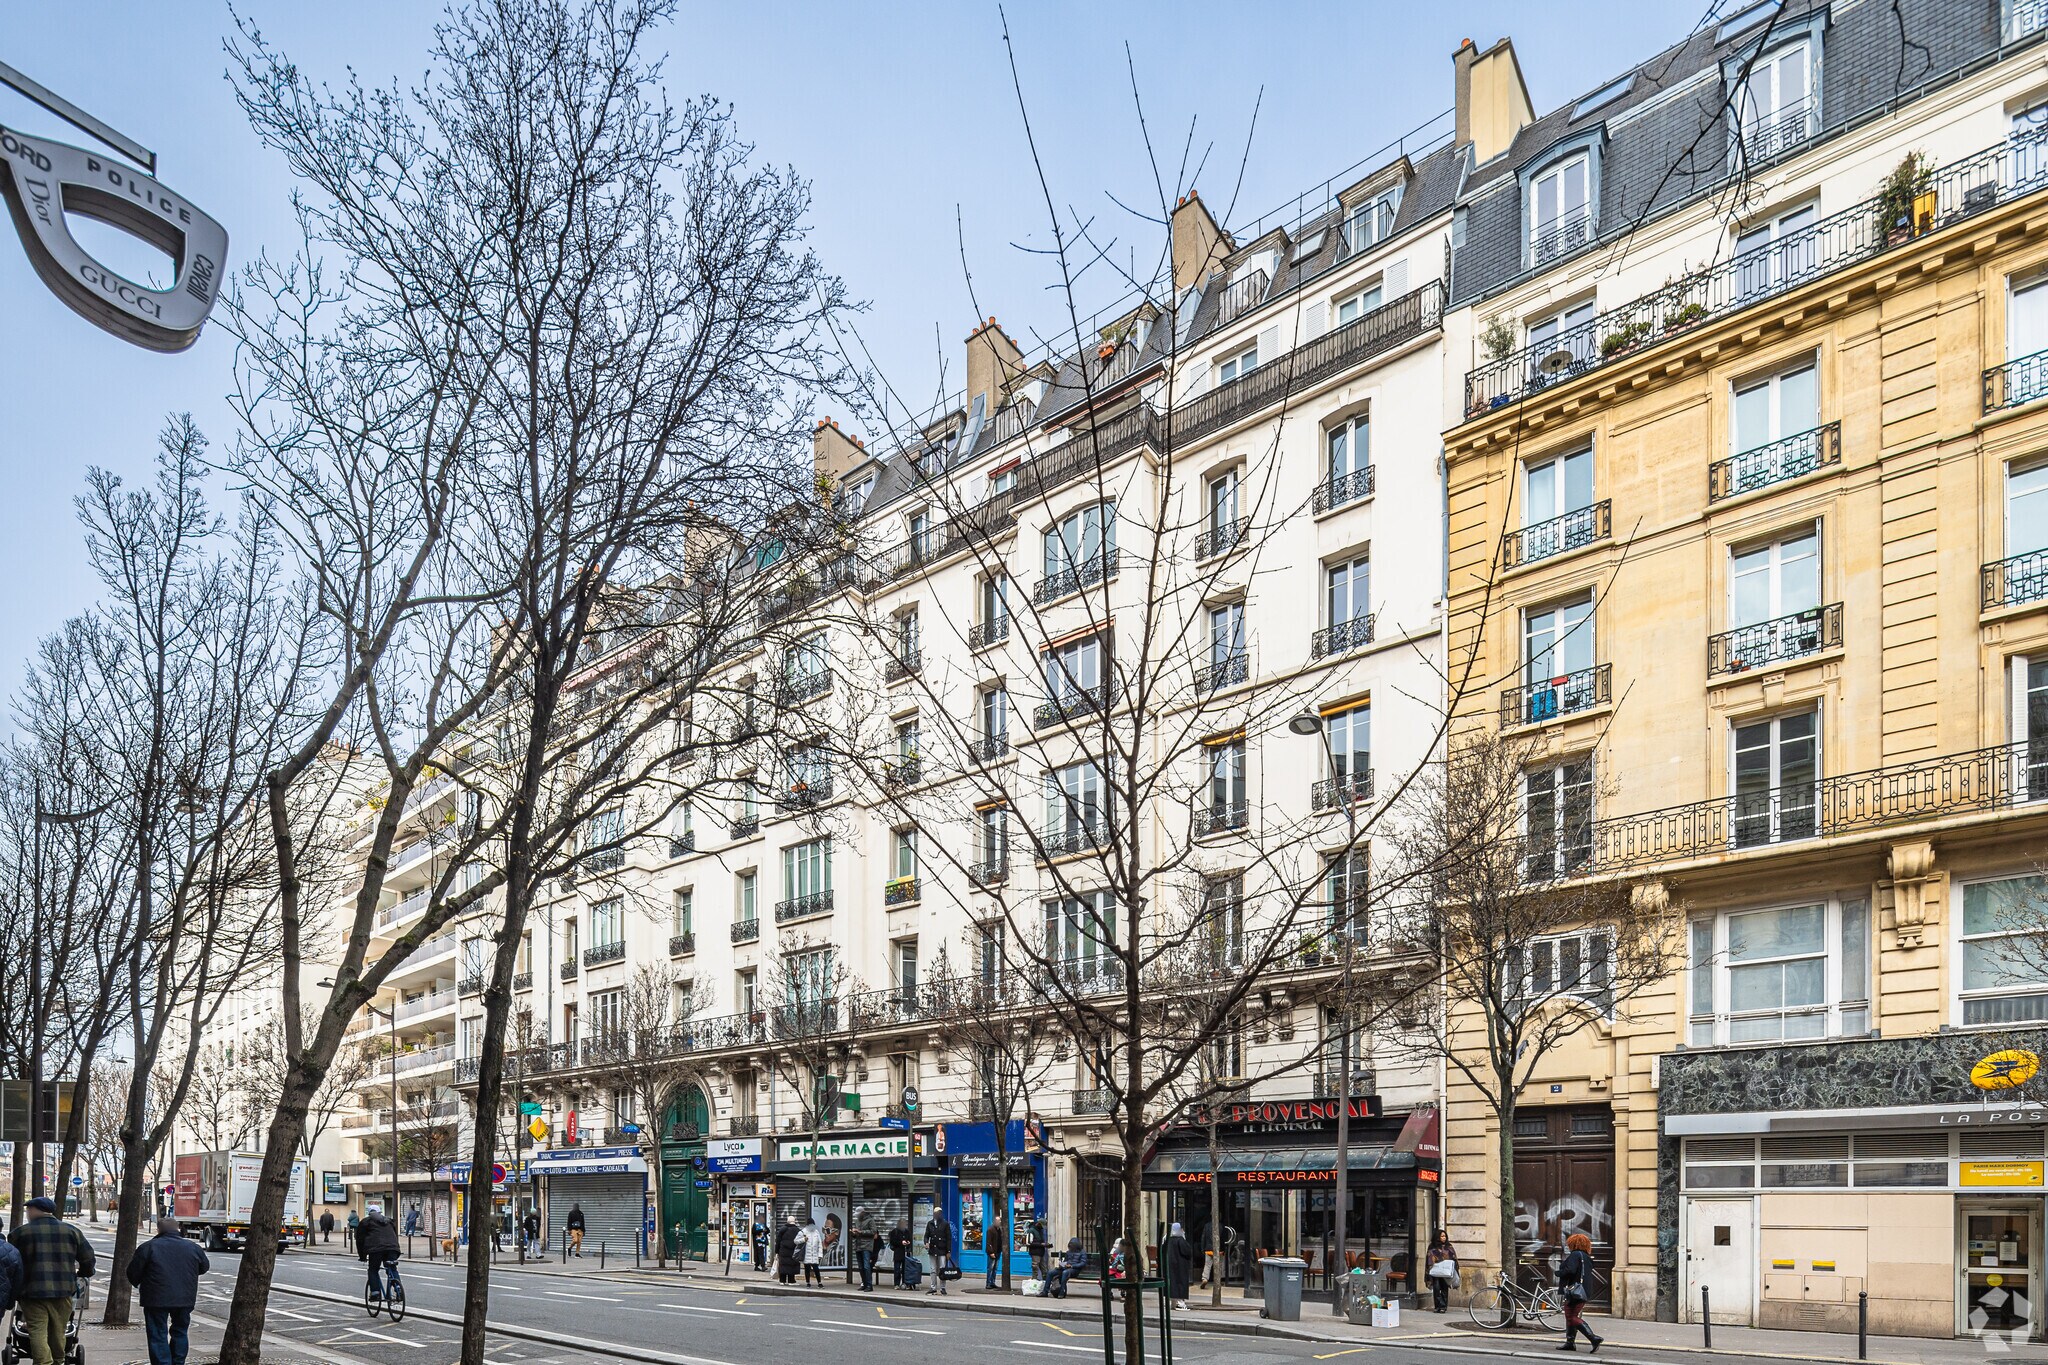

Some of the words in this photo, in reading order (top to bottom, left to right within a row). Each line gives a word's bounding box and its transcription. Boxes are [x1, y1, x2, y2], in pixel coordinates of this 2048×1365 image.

[0, 135, 52, 172] ORD
[87, 157, 192, 225] POLICE
[24, 176, 53, 227] Dior
[80, 264, 162, 320] GUCCI
[905, 1091, 917, 1101] BUS
[1940, 1114, 1970, 1124] LA
[1243, 1125, 1256, 1133] LE
[617, 1148, 634, 1156] PRESSE
[723, 1142, 740, 1152] Lyca
[791, 1141, 908, 1158] PHARMACIE
[725, 1157, 753, 1165] MULTIMEDIA
[582, 1165, 598, 1173] PRESSE
[602, 1164, 625, 1172] CADEAUX
[1178, 1172, 1212, 1183] CAFE
[1237, 1170, 1338, 1182] RESTAURANT
[761, 1186, 774, 1195] Ria
[813, 1196, 846, 1209] LOEWE
